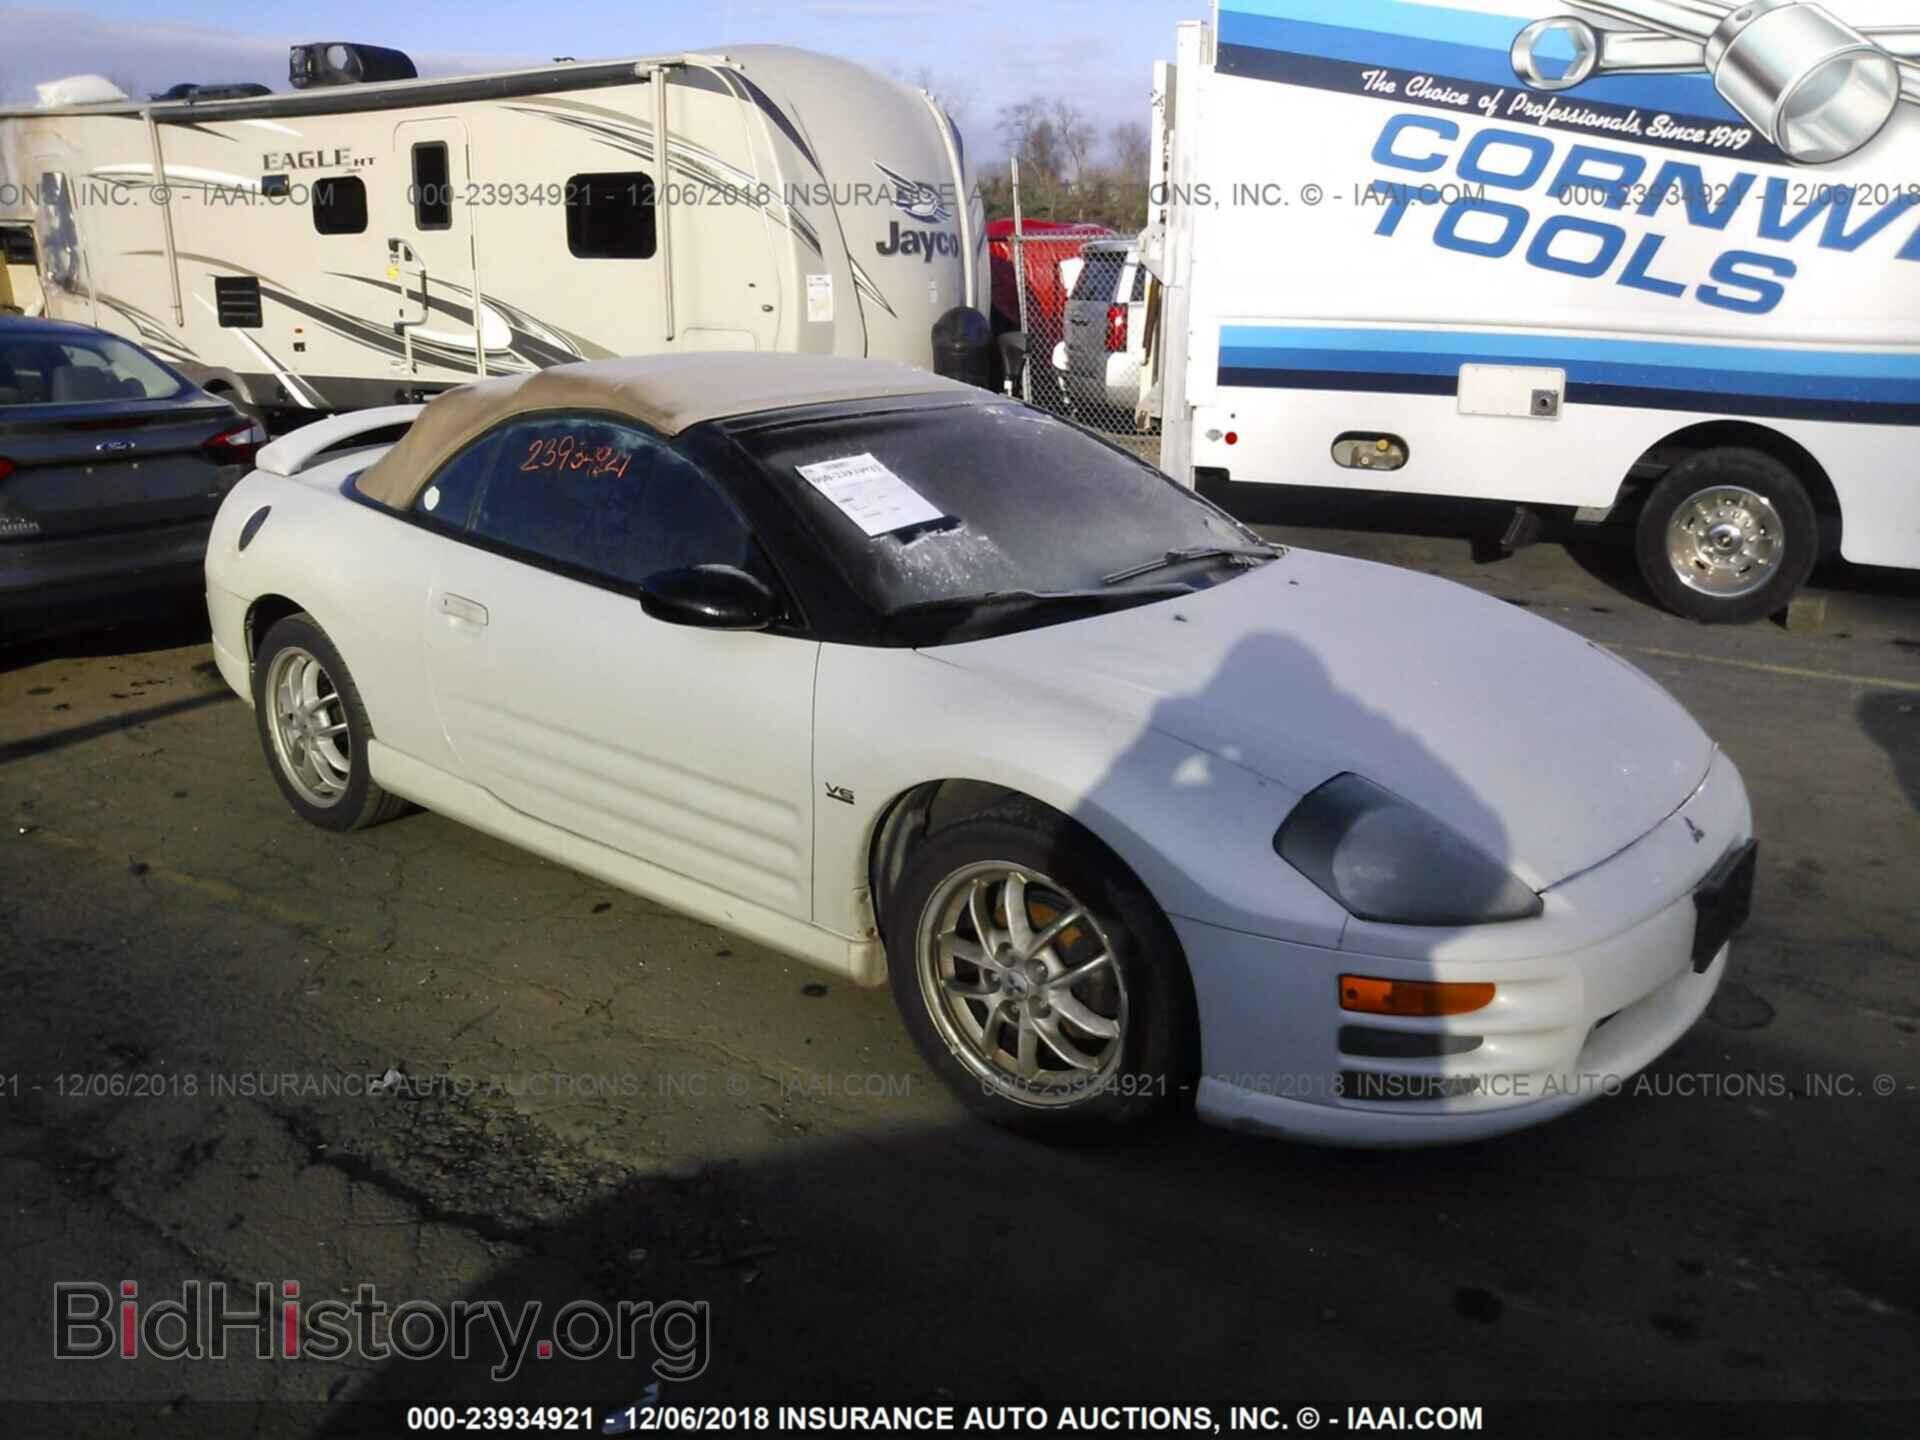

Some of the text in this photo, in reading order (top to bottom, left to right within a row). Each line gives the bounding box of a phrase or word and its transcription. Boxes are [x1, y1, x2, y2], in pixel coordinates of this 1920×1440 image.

[1362, 69, 1397, 94] The
[1404, 76, 1470, 105] Choice
[1478, 89, 1504, 117] of
[1646, 114, 1705, 143] Since
[1705, 125, 1752, 150] 1919
[262, 147, 352, 171] EAGLE
[875, 221, 958, 263] Jayco
[1372, 179, 1798, 315] TOOLS
[825, 782, 854, 800] V6
